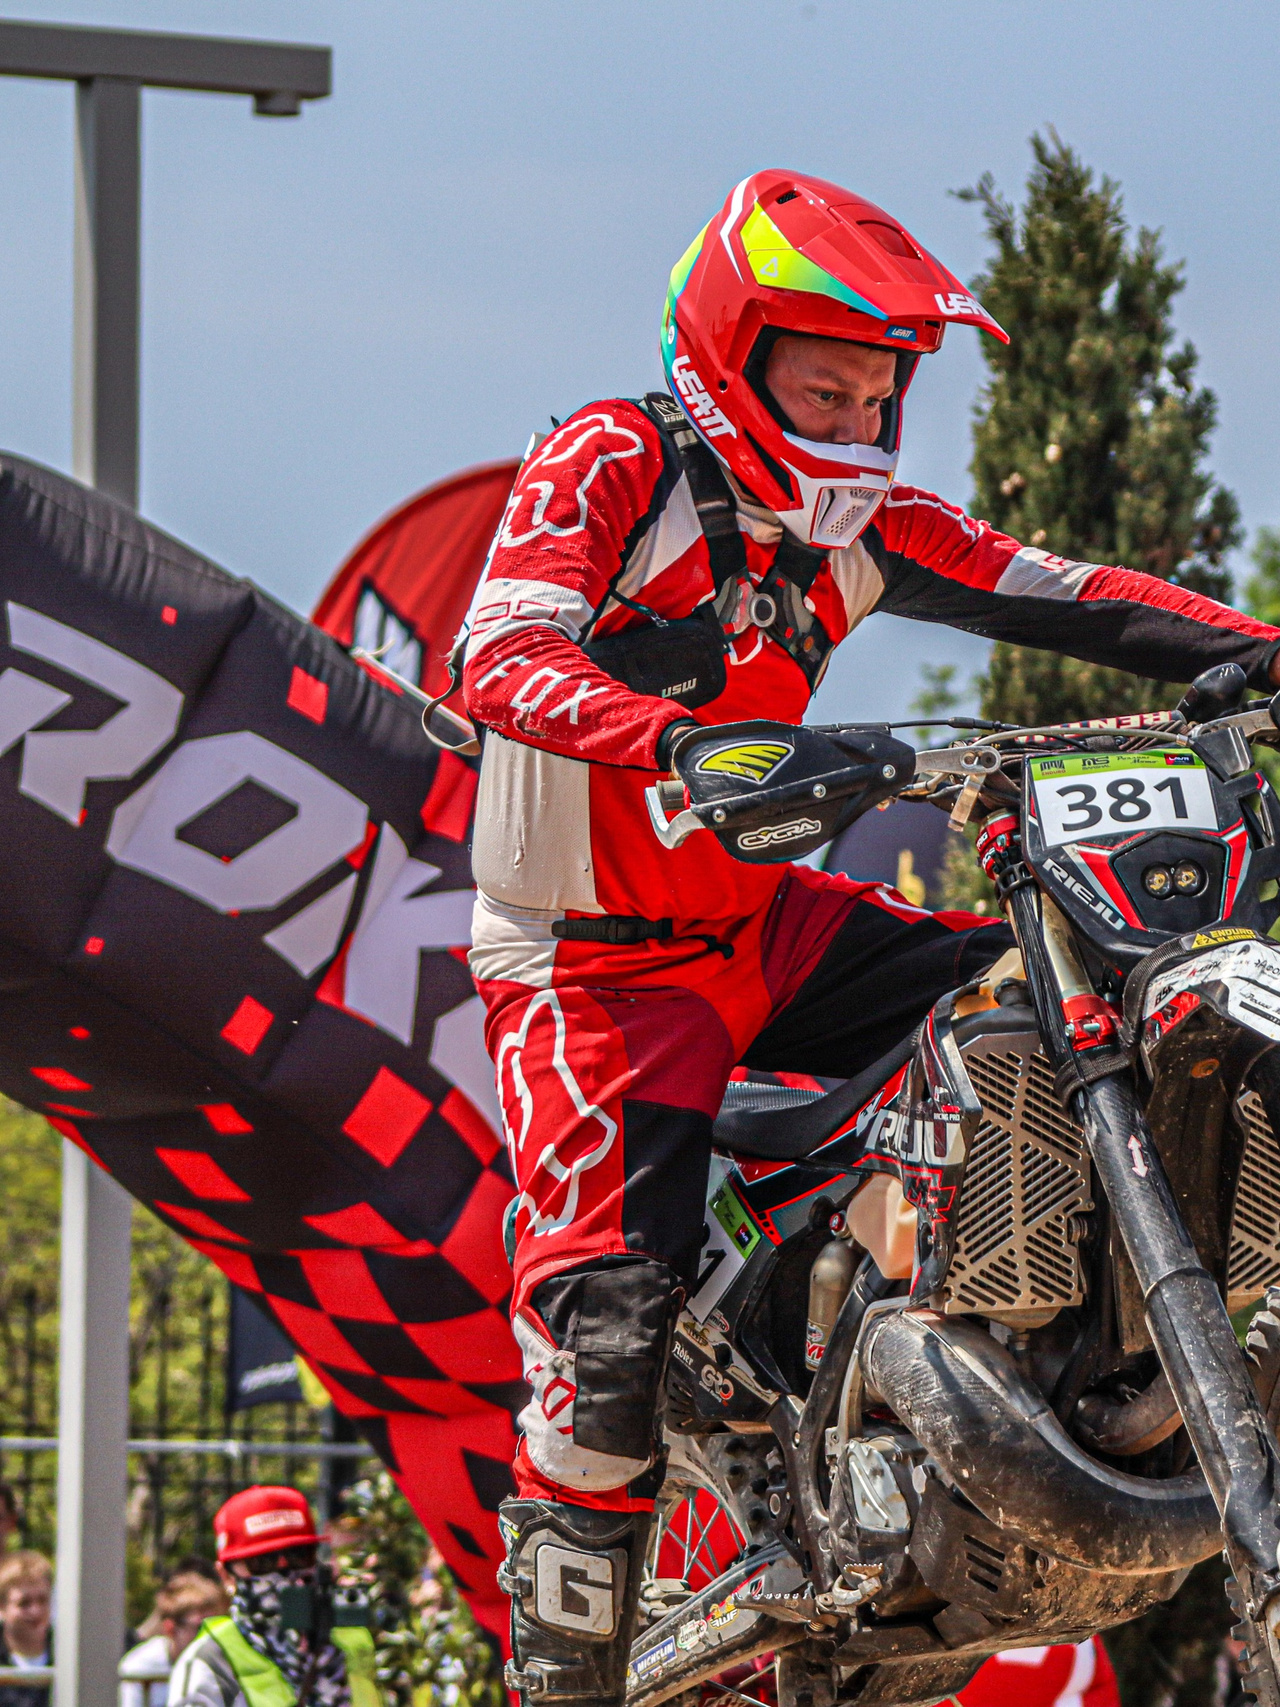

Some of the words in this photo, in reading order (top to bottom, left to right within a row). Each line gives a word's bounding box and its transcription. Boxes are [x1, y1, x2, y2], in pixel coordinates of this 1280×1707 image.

[891, 327, 913, 338] LEATT
[671, 354, 738, 439] LEATT
[474, 654, 609, 725] FOX
[1056, 777, 1189, 832] 381
[740, 821, 818, 845] CYCRA
[1042, 858, 1127, 930] RIEJU
[1209, 929, 1255, 938] ENDURO
